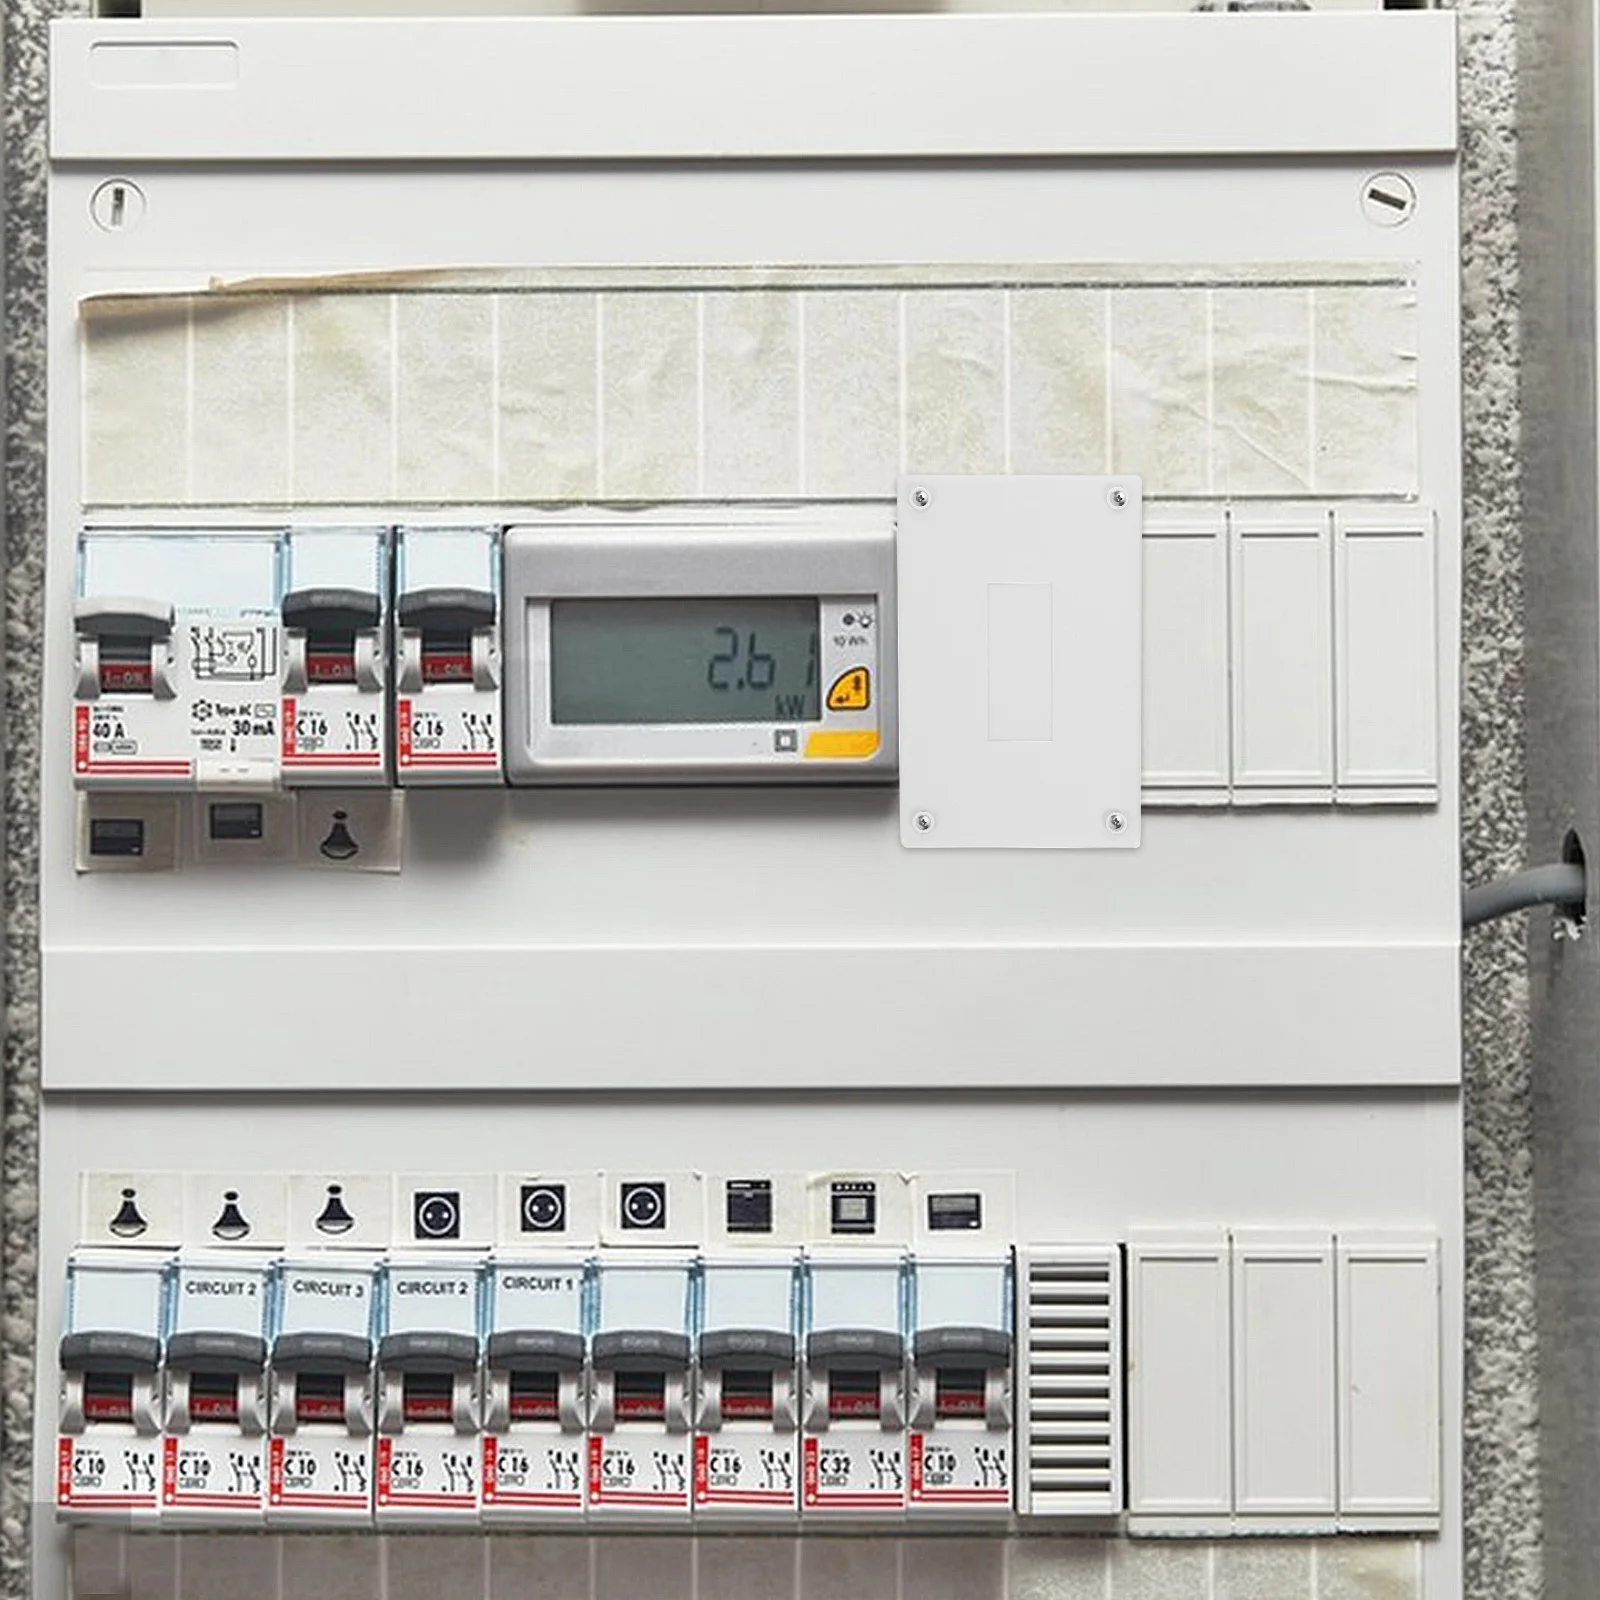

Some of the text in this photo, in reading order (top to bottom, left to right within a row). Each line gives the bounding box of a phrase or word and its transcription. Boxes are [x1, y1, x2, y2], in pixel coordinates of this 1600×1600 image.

[215, 703, 236, 717] Type
[775, 695, 806, 718] kW
[93, 722, 125, 738] 40 A
[233, 719, 251, 736] 30
[252, 720, 276, 736] mA
[296, 720, 305, 735] C
[311, 719, 328, 736] 16
[411, 720, 421, 736] C
[427, 720, 444, 736] 16
[186, 1281, 257, 1296] CIRCUIT 2
[293, 1280, 364, 1298] CIRCUIT 3
[397, 1281, 468, 1295] CIRCUIT 2
[503, 1276, 573, 1291] CIRCUIT 1
[74, 1458, 106, 1475] C 10
[179, 1459, 211, 1476] C 10
[284, 1459, 317, 1475] C 10
[391, 1459, 424, 1476] C 16
[497, 1456, 529, 1473] C 16
[603, 1457, 635, 1475] C 16
[709, 1456, 742, 1473] C 16
[820, 1457, 851, 1474] C 32
[924, 1455, 957, 1472] C 10
